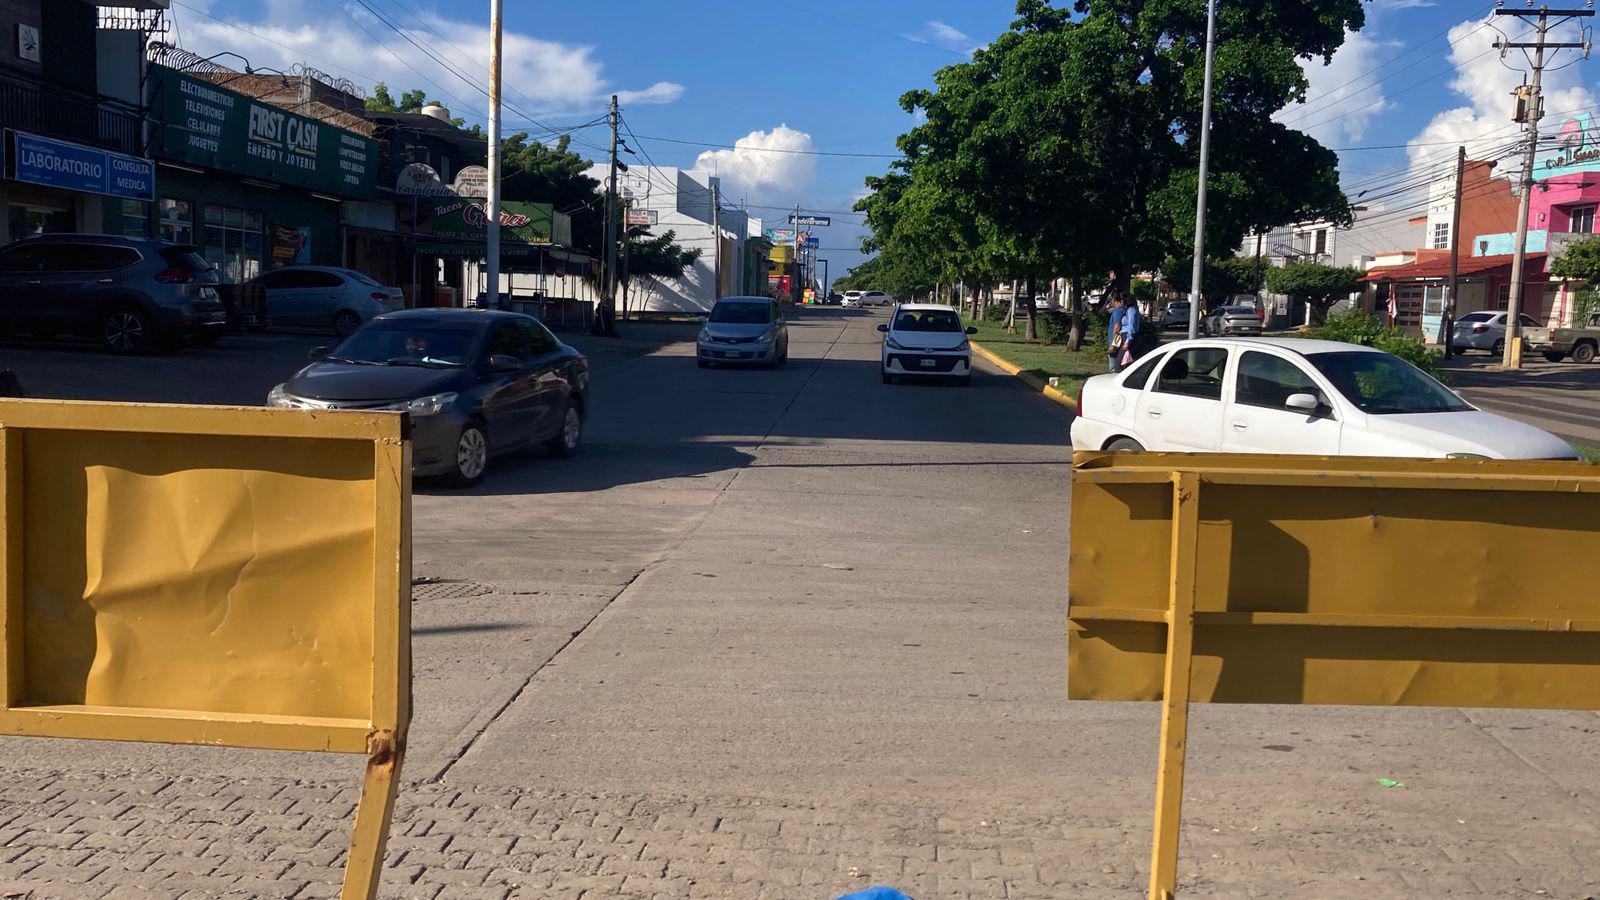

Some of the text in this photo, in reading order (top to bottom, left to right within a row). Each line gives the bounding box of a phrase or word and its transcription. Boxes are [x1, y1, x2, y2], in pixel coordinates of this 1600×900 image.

[185, 99, 225, 121] TELEVISIONES
[187, 117, 221, 137] CELULARES
[248, 104, 318, 151] FIRST CASH
[188, 134, 218, 152] JUGUETES
[247, 142, 276, 161] EMPEÑO
[278, 151, 283, 163] Y
[21, 150, 102, 178] LABORATORIO
[112, 159, 150, 175] CONSULTA
[117, 177, 146, 190] MEDICA
[434, 202, 463, 216] Tacos
